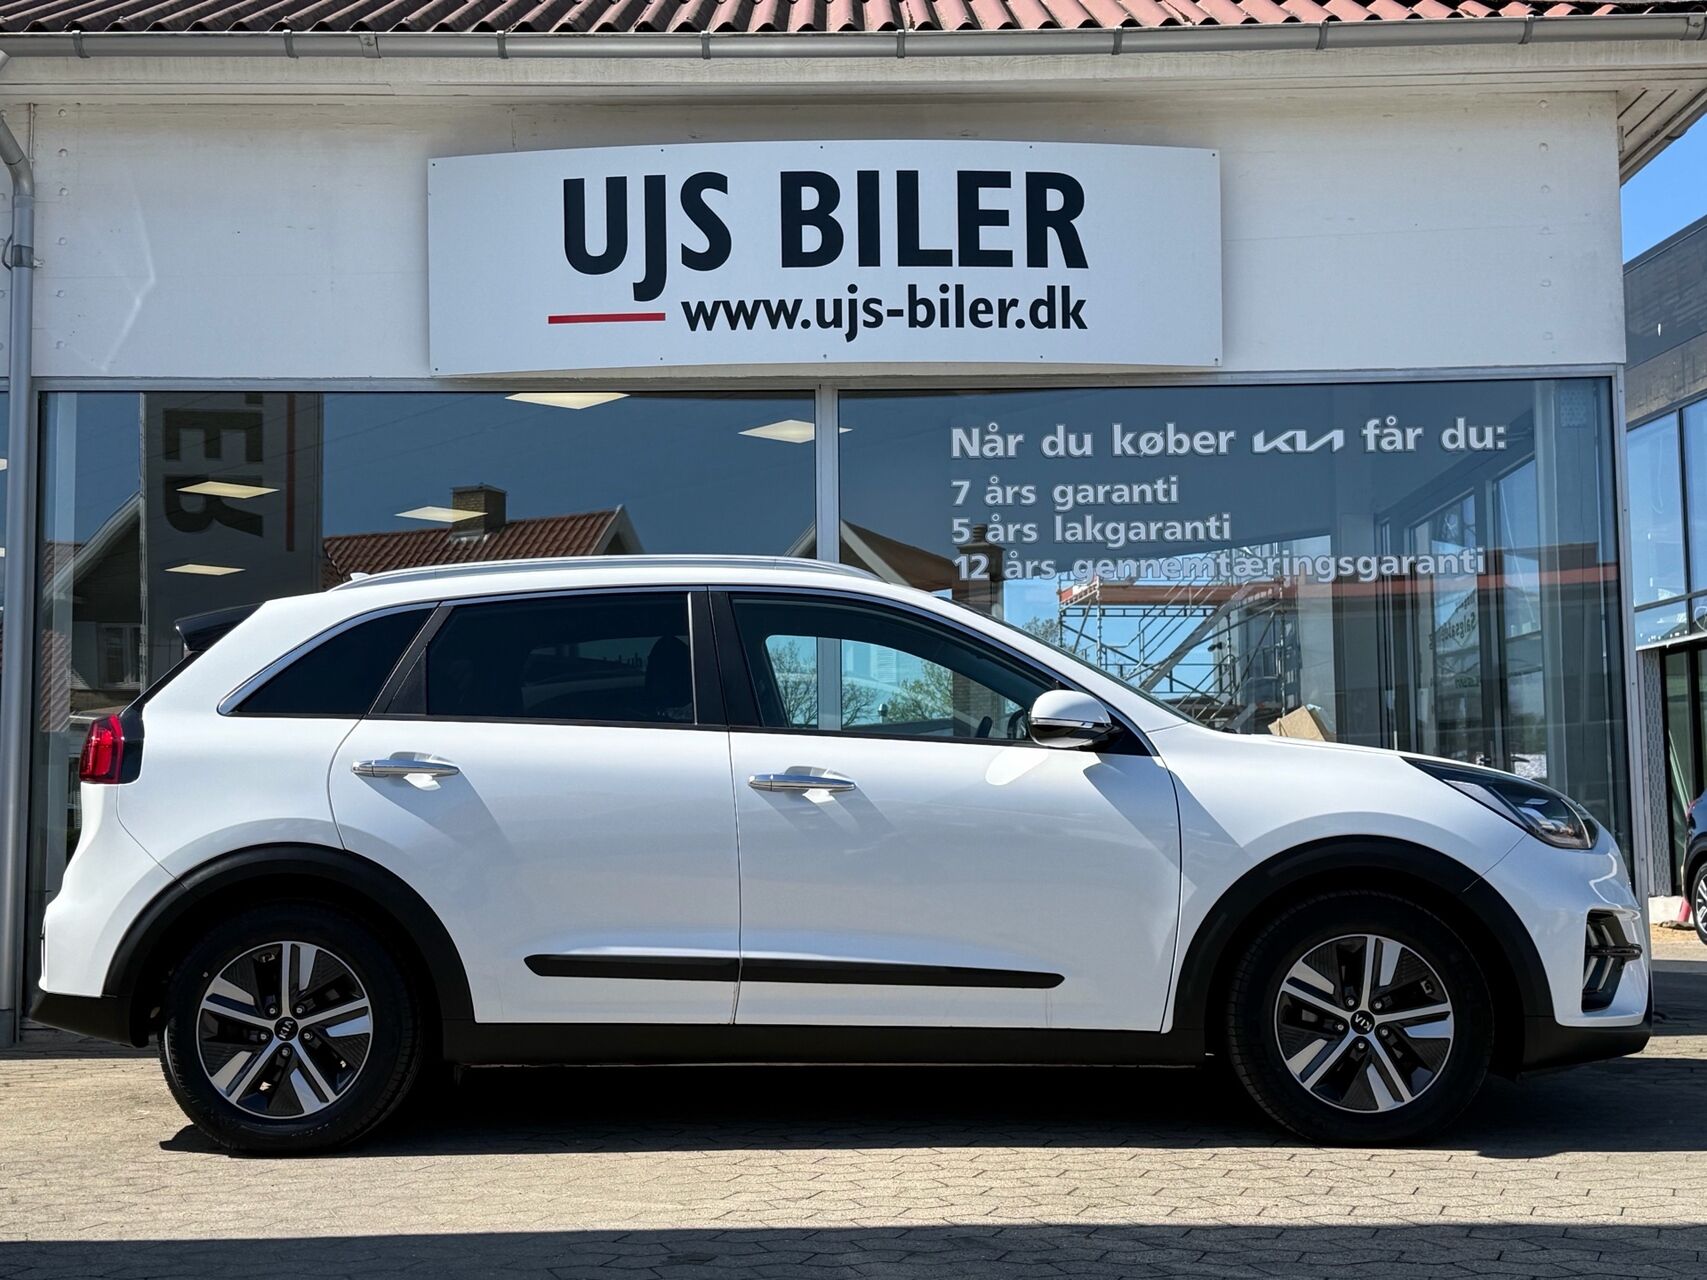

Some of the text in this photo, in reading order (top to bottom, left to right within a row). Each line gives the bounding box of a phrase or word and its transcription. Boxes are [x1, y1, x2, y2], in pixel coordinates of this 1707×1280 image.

[563, 170, 1090, 302] UJS BILER
[681, 283, 1088, 343] www.ujs-biler.dk
[950, 421, 1024, 458] Når
[1040, 424, 1094, 458] du
[1111, 422, 1236, 458] køber
[1361, 415, 1424, 453] får
[1440, 416, 1508, 452] du:
[950, 475, 1179, 512] 7 års garanti
[951, 513, 1232, 549] 5 års lakgaranti
[954, 553, 991, 581] 12
[1003, 550, 1057, 581] års
